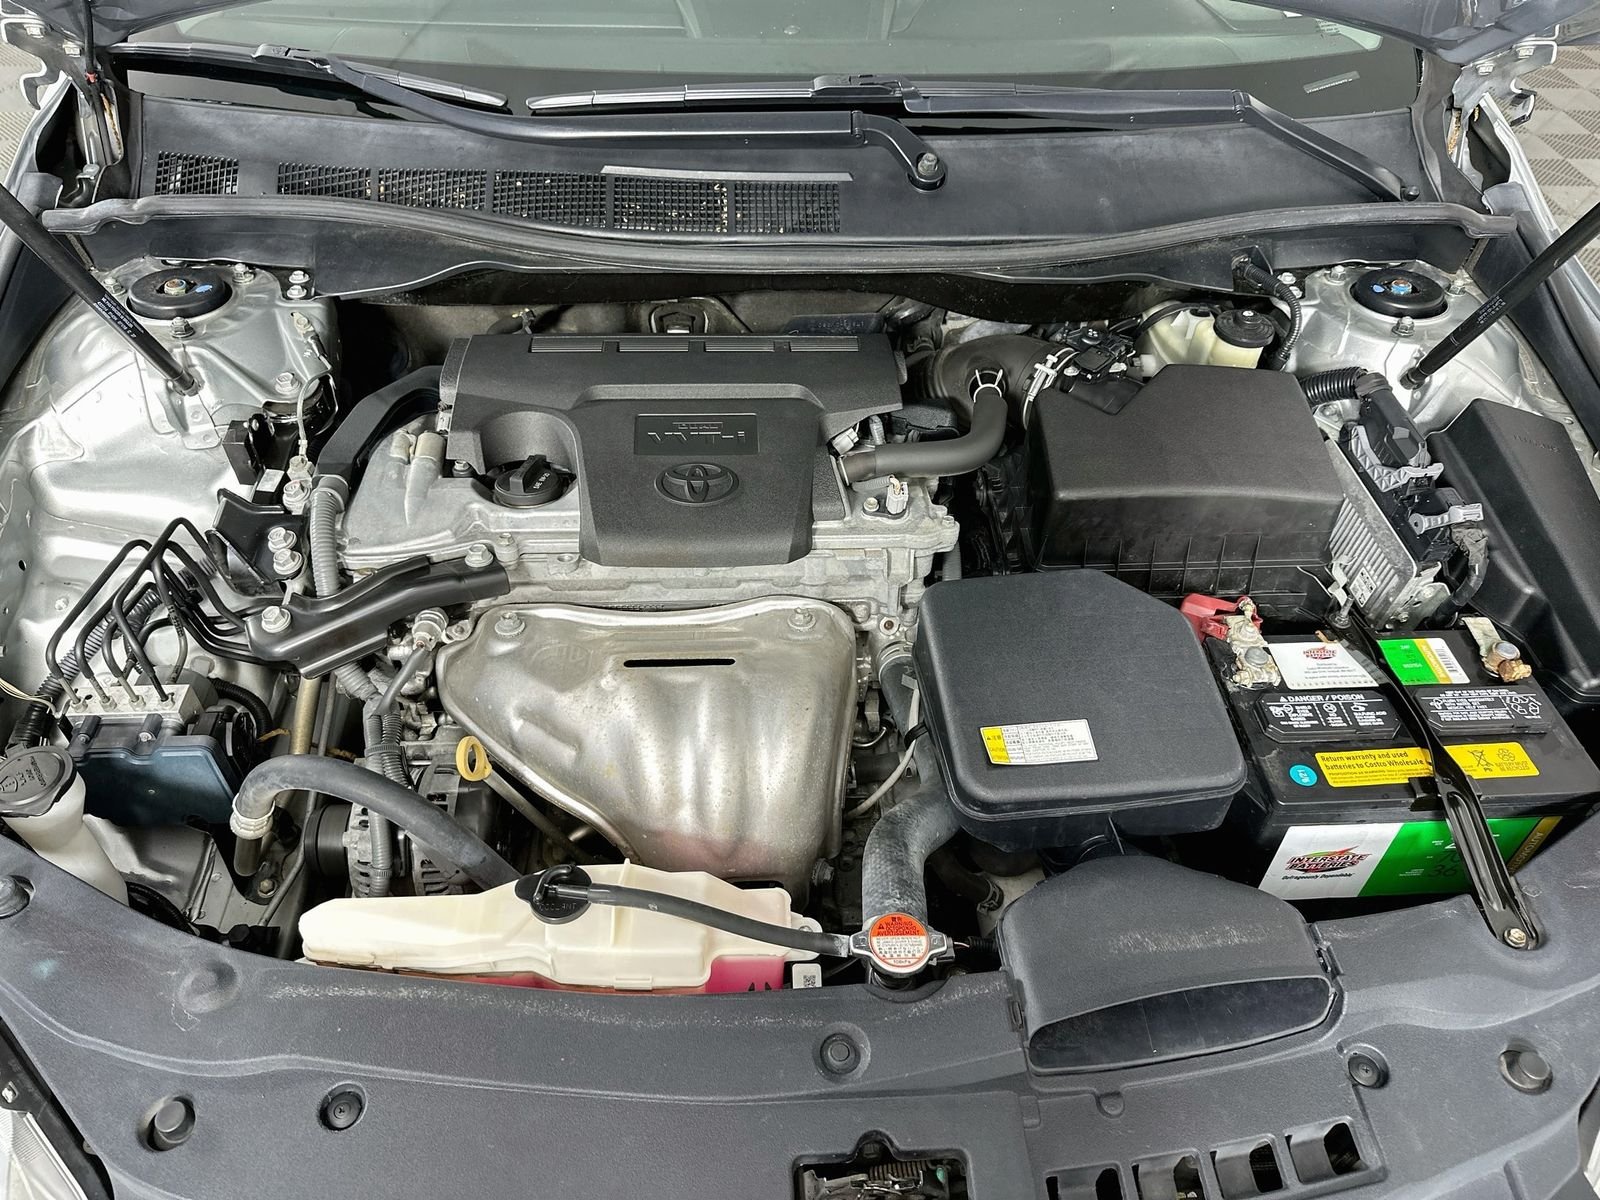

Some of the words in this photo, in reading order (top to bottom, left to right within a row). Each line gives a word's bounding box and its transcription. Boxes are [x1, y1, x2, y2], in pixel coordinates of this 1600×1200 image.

[1287, 694, 1324, 702] DANGER
[1331, 693, 1365, 701] POISON
[1345, 753, 1376, 761] warranty
[1391, 751, 1408, 759] used
[1325, 762, 1355, 770] batteries
[1356, 761, 1363, 769] to
[1364, 760, 1388, 768] Costco
[1388, 758, 1424, 767] Wholesale
[1286, 854, 1370, 864] INTERSTATE
[1285, 860, 1360, 870] BATTERIES
